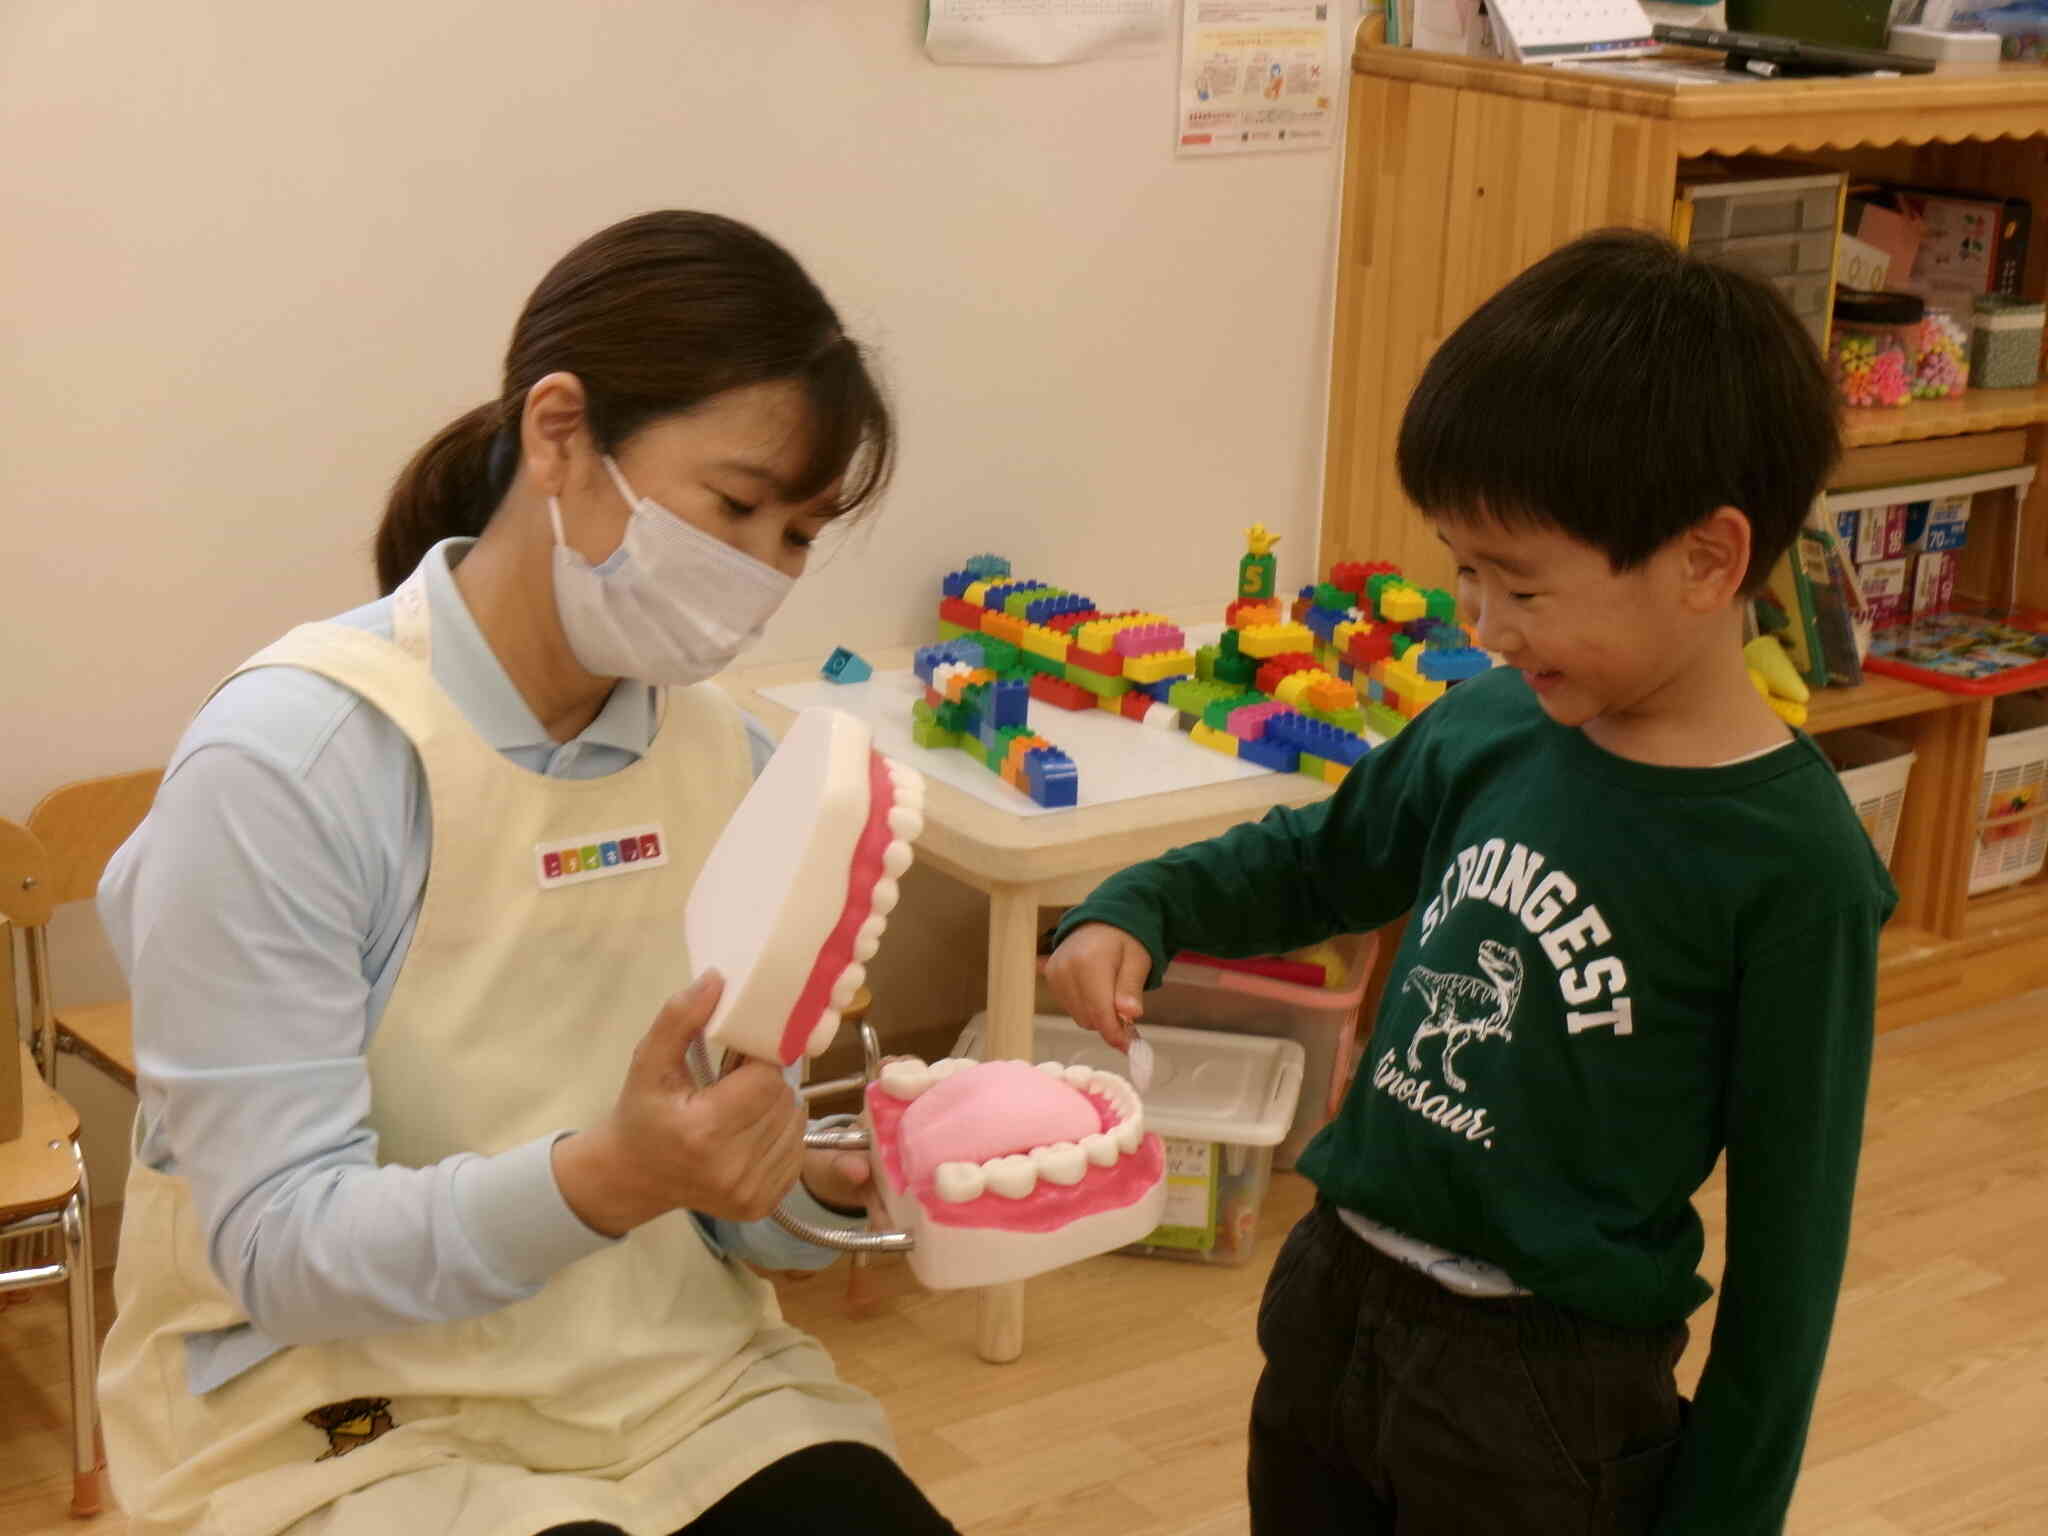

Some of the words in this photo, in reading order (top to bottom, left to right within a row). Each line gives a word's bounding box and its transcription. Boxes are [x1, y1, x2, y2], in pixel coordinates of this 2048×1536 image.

[1243, 565, 1264, 593] 5
[1420, 838, 1633, 1035] STRONGEST
[1373, 1048, 1495, 1150] inosaur.
